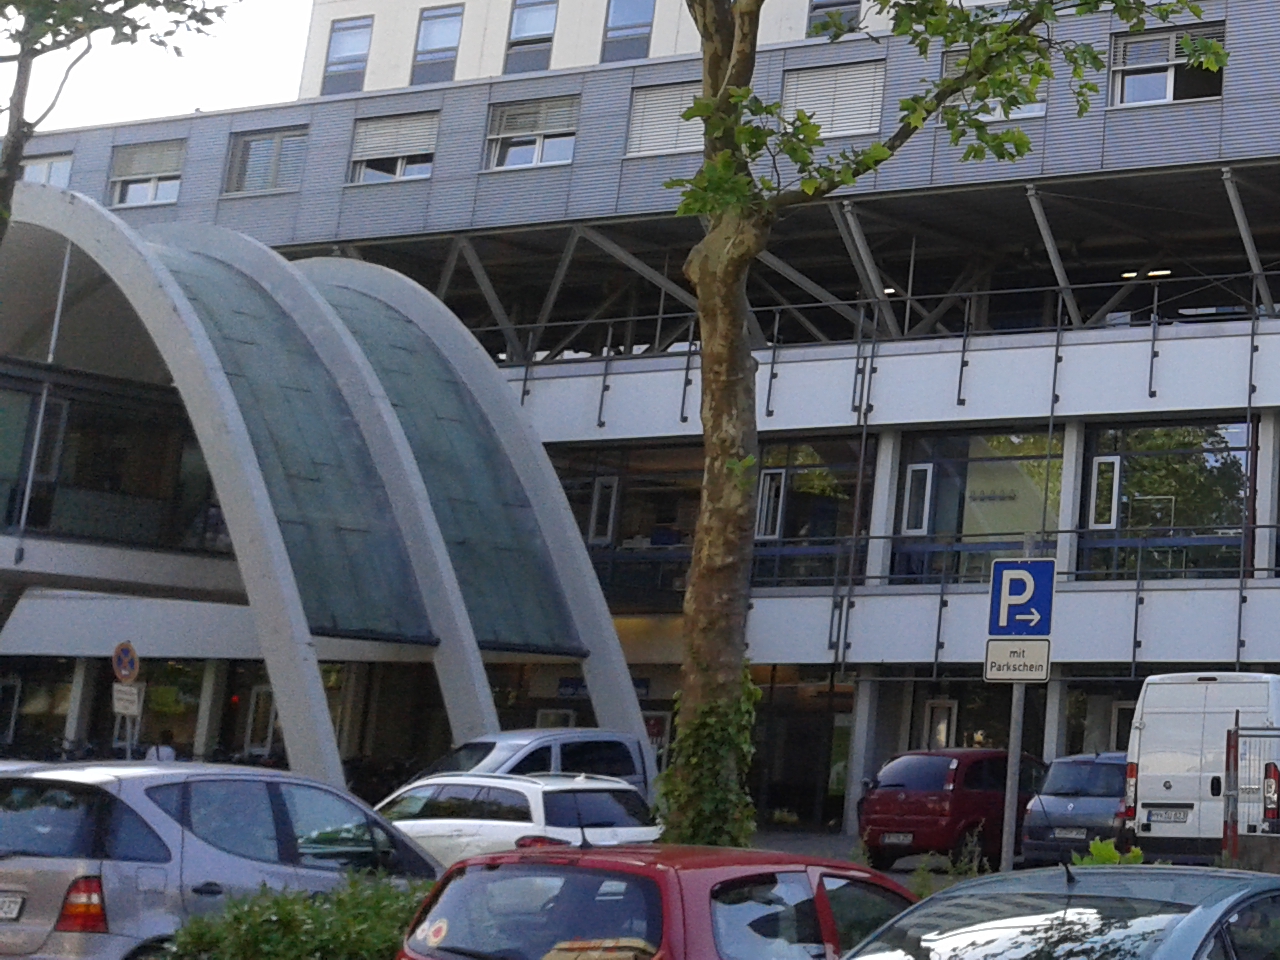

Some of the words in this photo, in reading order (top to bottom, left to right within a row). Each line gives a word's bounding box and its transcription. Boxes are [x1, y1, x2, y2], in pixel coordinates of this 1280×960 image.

[998, 569, 1035, 627] P
[1009, 648, 1026, 658] mit
[990, 661, 1044, 672] Parkschein
